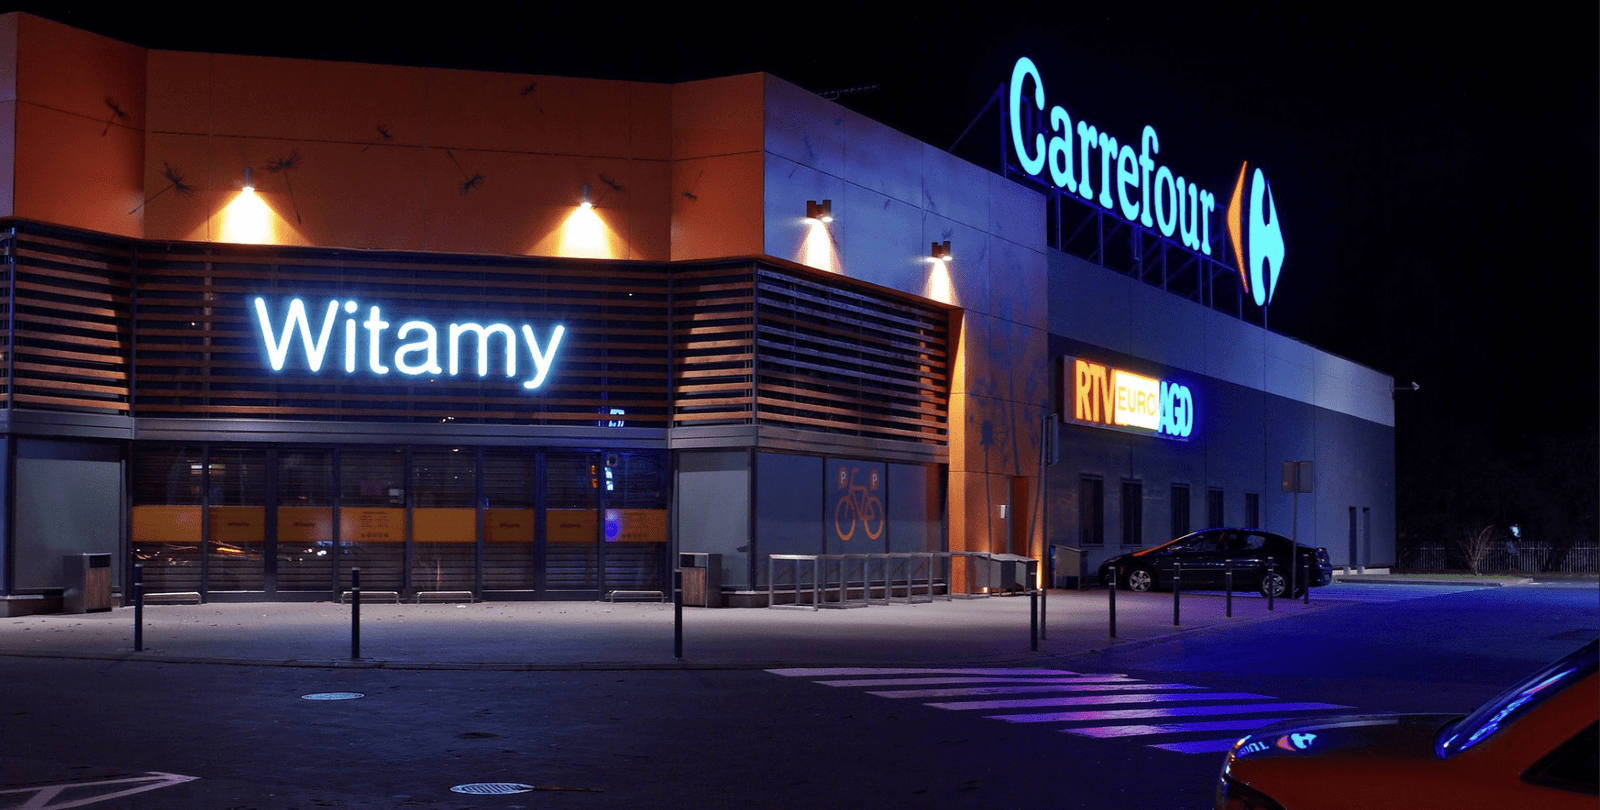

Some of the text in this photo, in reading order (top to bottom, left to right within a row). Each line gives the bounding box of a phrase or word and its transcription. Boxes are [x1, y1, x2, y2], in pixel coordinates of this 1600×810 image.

[1009, 56, 1215, 256] Carrefour
[254, 297, 566, 390] Witamy
[1075, 359, 1194, 438] RTV EURO AGD
[840, 470, 847, 484] P
[872, 473, 878, 486] P
